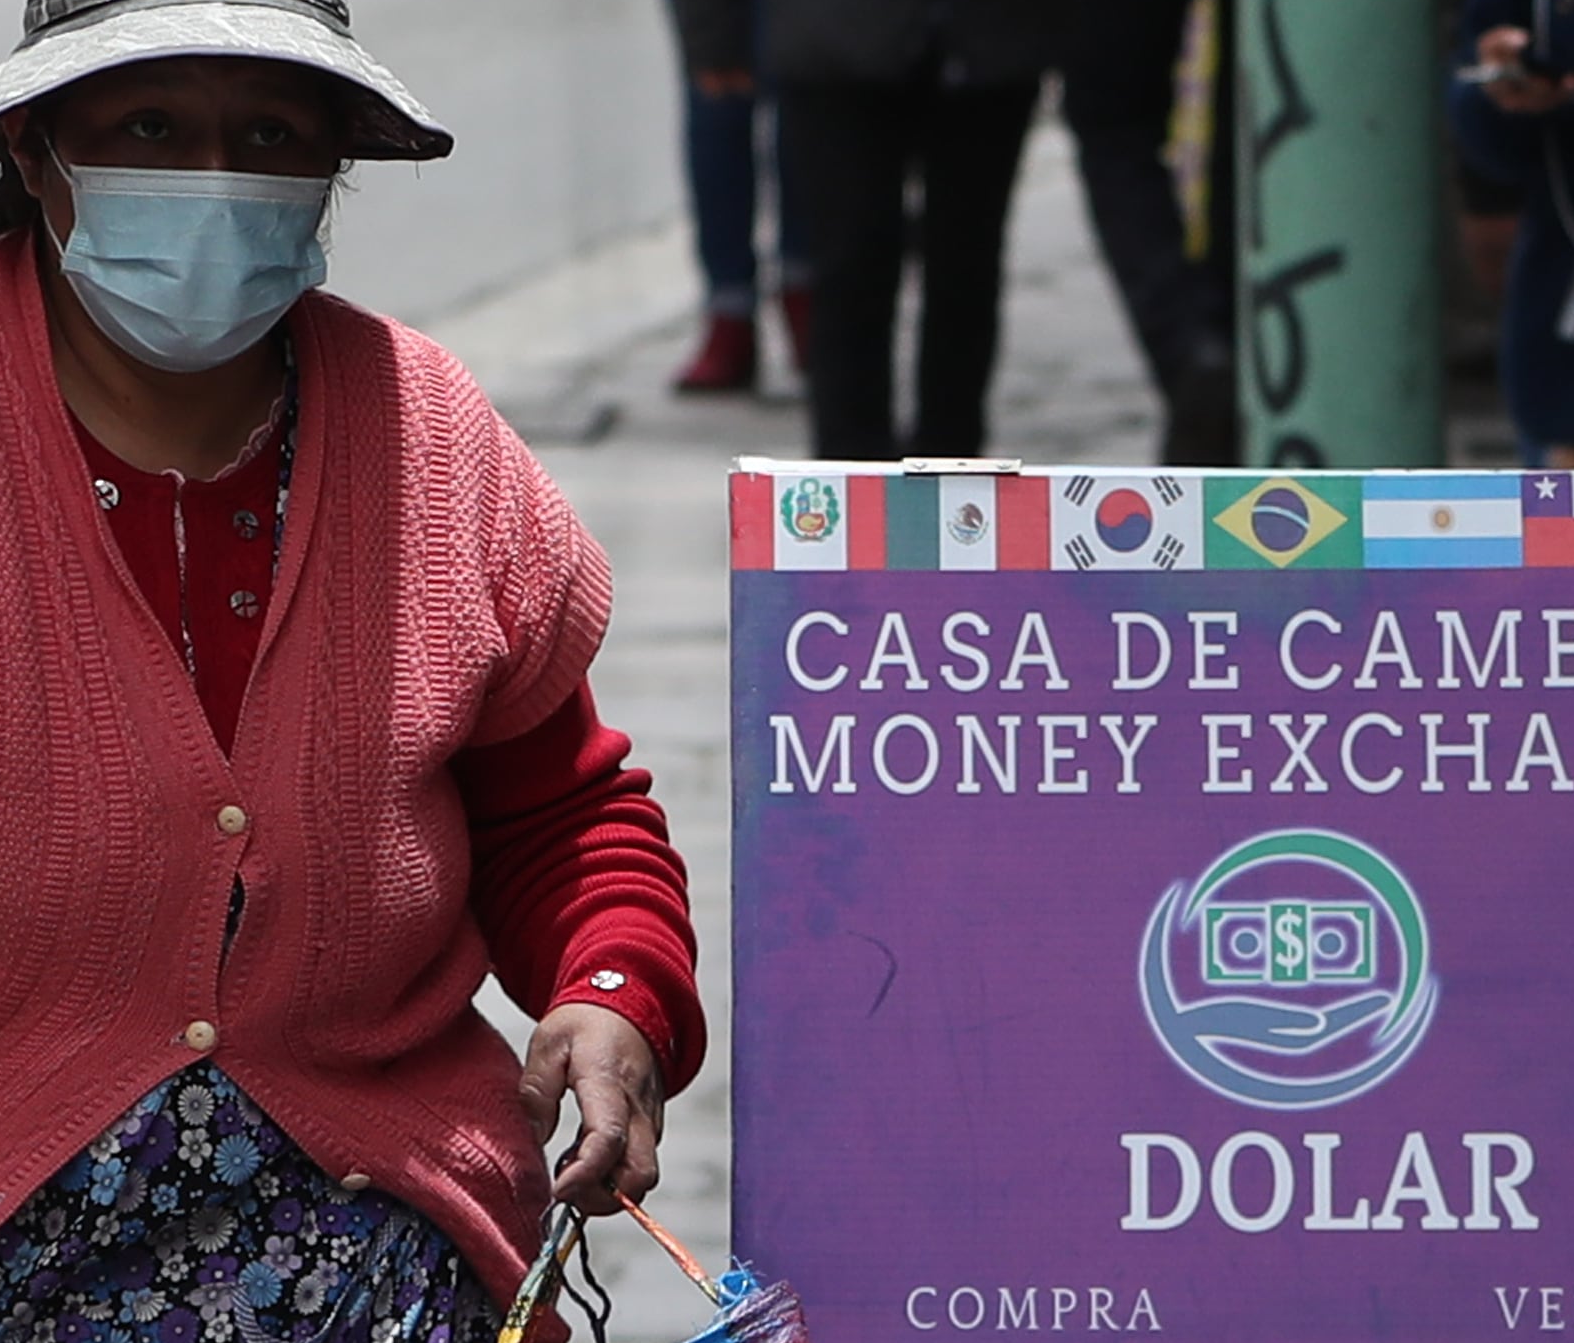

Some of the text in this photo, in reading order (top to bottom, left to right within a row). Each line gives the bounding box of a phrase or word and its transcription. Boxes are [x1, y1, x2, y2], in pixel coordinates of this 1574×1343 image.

[785, 610, 1069, 692] CASA
[1110, 611, 1240, 690] DE
[768, 713, 1158, 795] MONEY
[1119, 1131, 1540, 1234] DOLAR
[905, 1286, 1164, 1332] COMPRA
